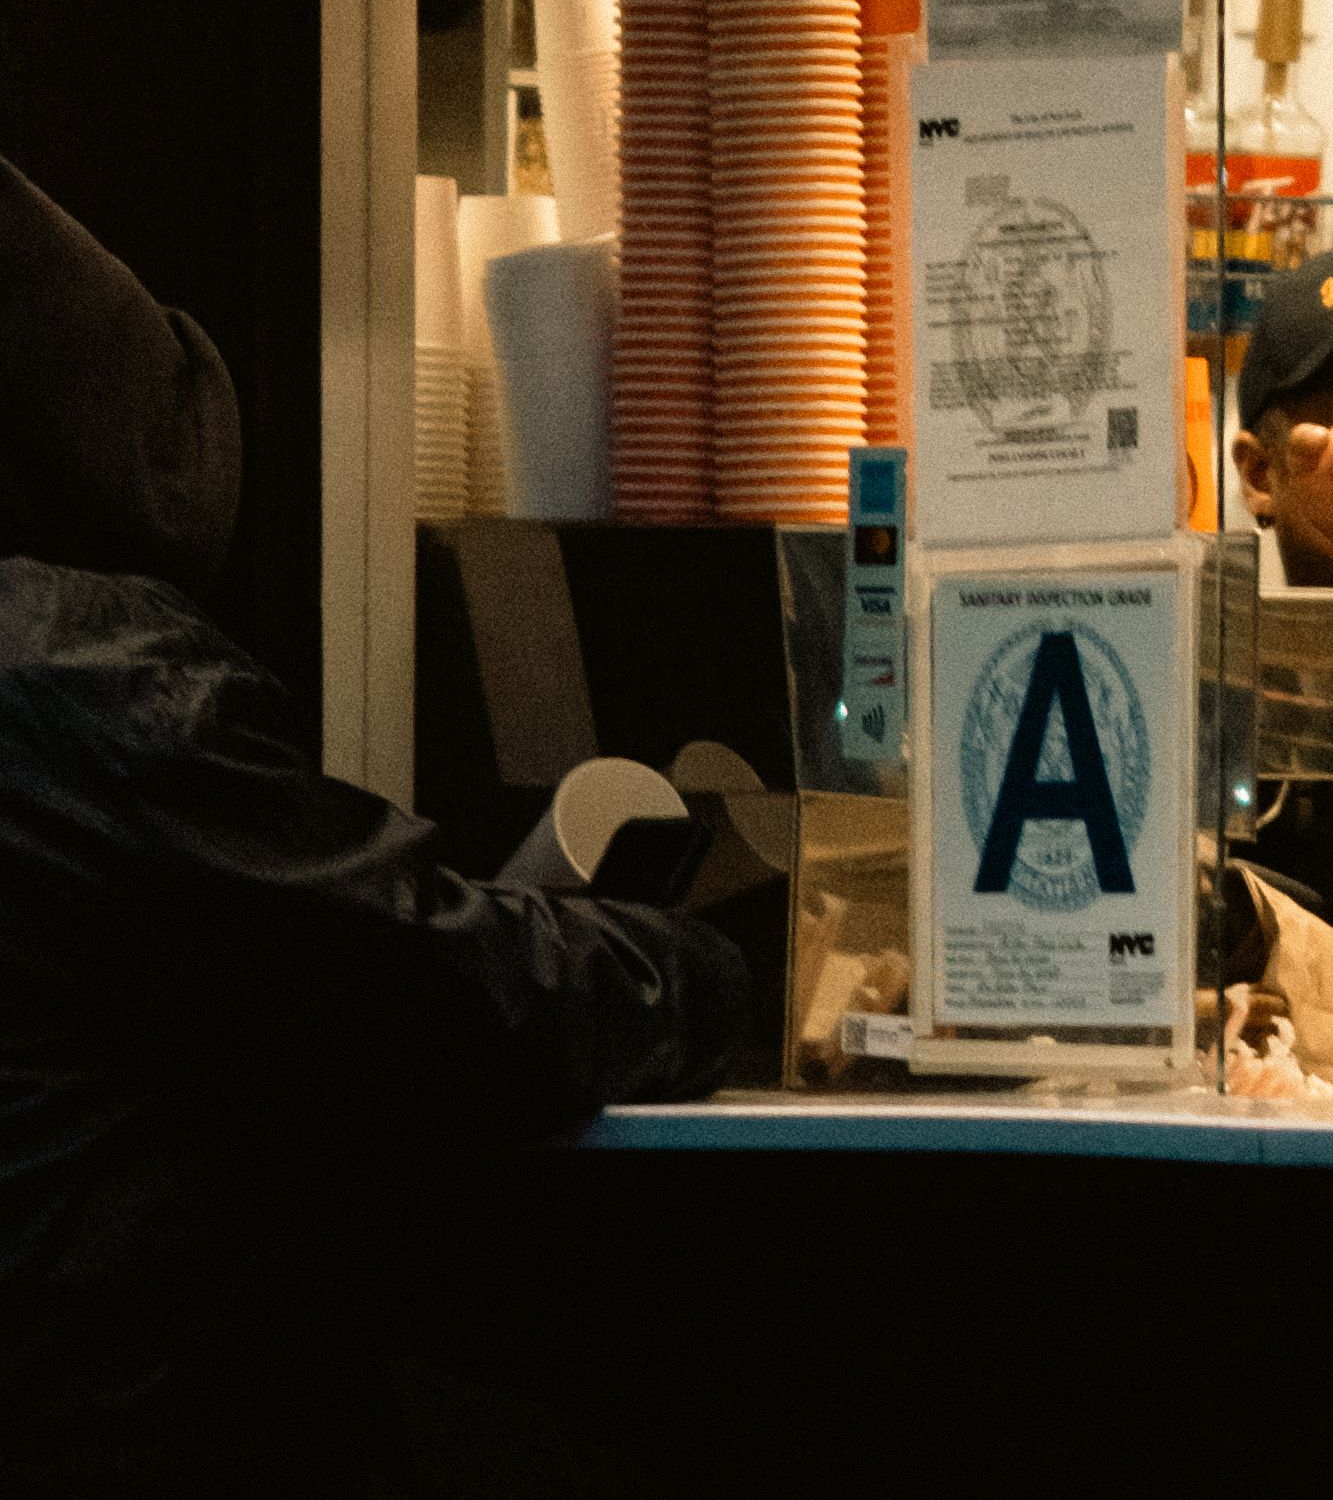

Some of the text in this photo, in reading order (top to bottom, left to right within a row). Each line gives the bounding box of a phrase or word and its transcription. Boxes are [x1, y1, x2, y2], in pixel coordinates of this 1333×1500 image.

[918, 117, 960, 138] NYC
[973, 632, 1137, 893] A
[1108, 933, 1155, 956] NYC
